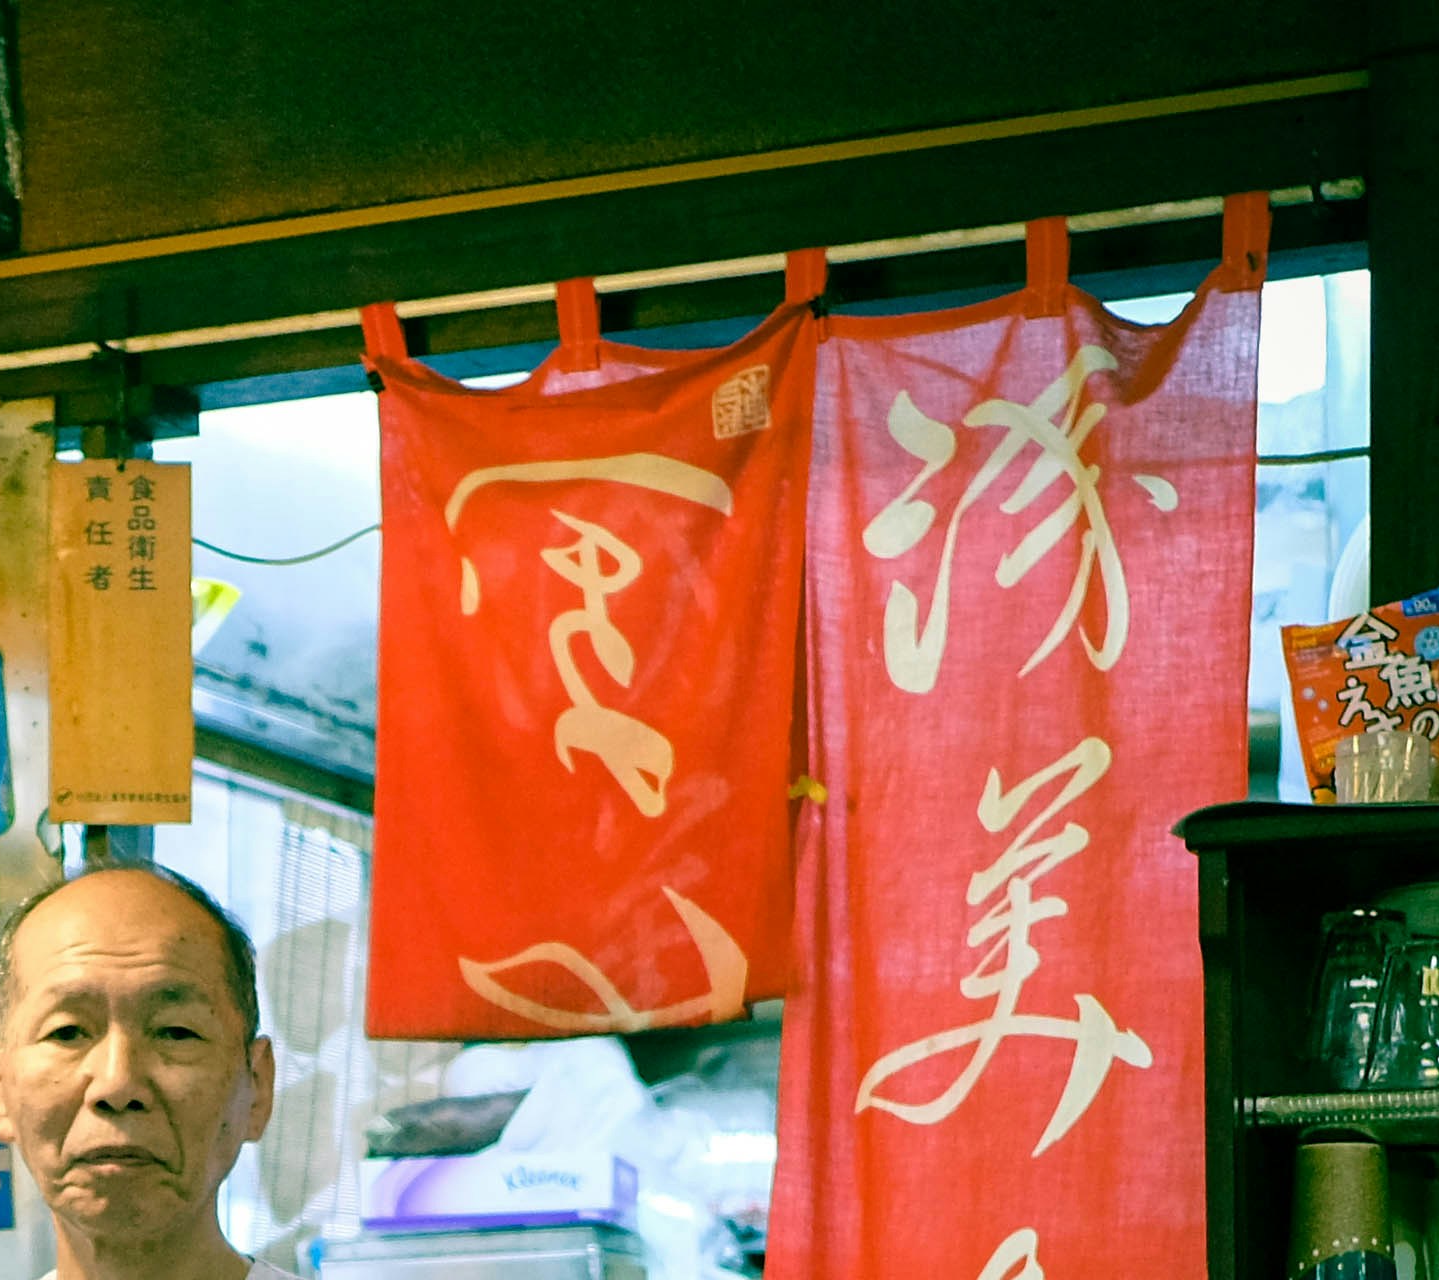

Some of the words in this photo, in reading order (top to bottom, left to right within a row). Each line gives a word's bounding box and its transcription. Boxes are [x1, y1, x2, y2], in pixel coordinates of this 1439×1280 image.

[83, 475, 115, 592] 責任者
[127, 475, 157, 592] 食品衛生
